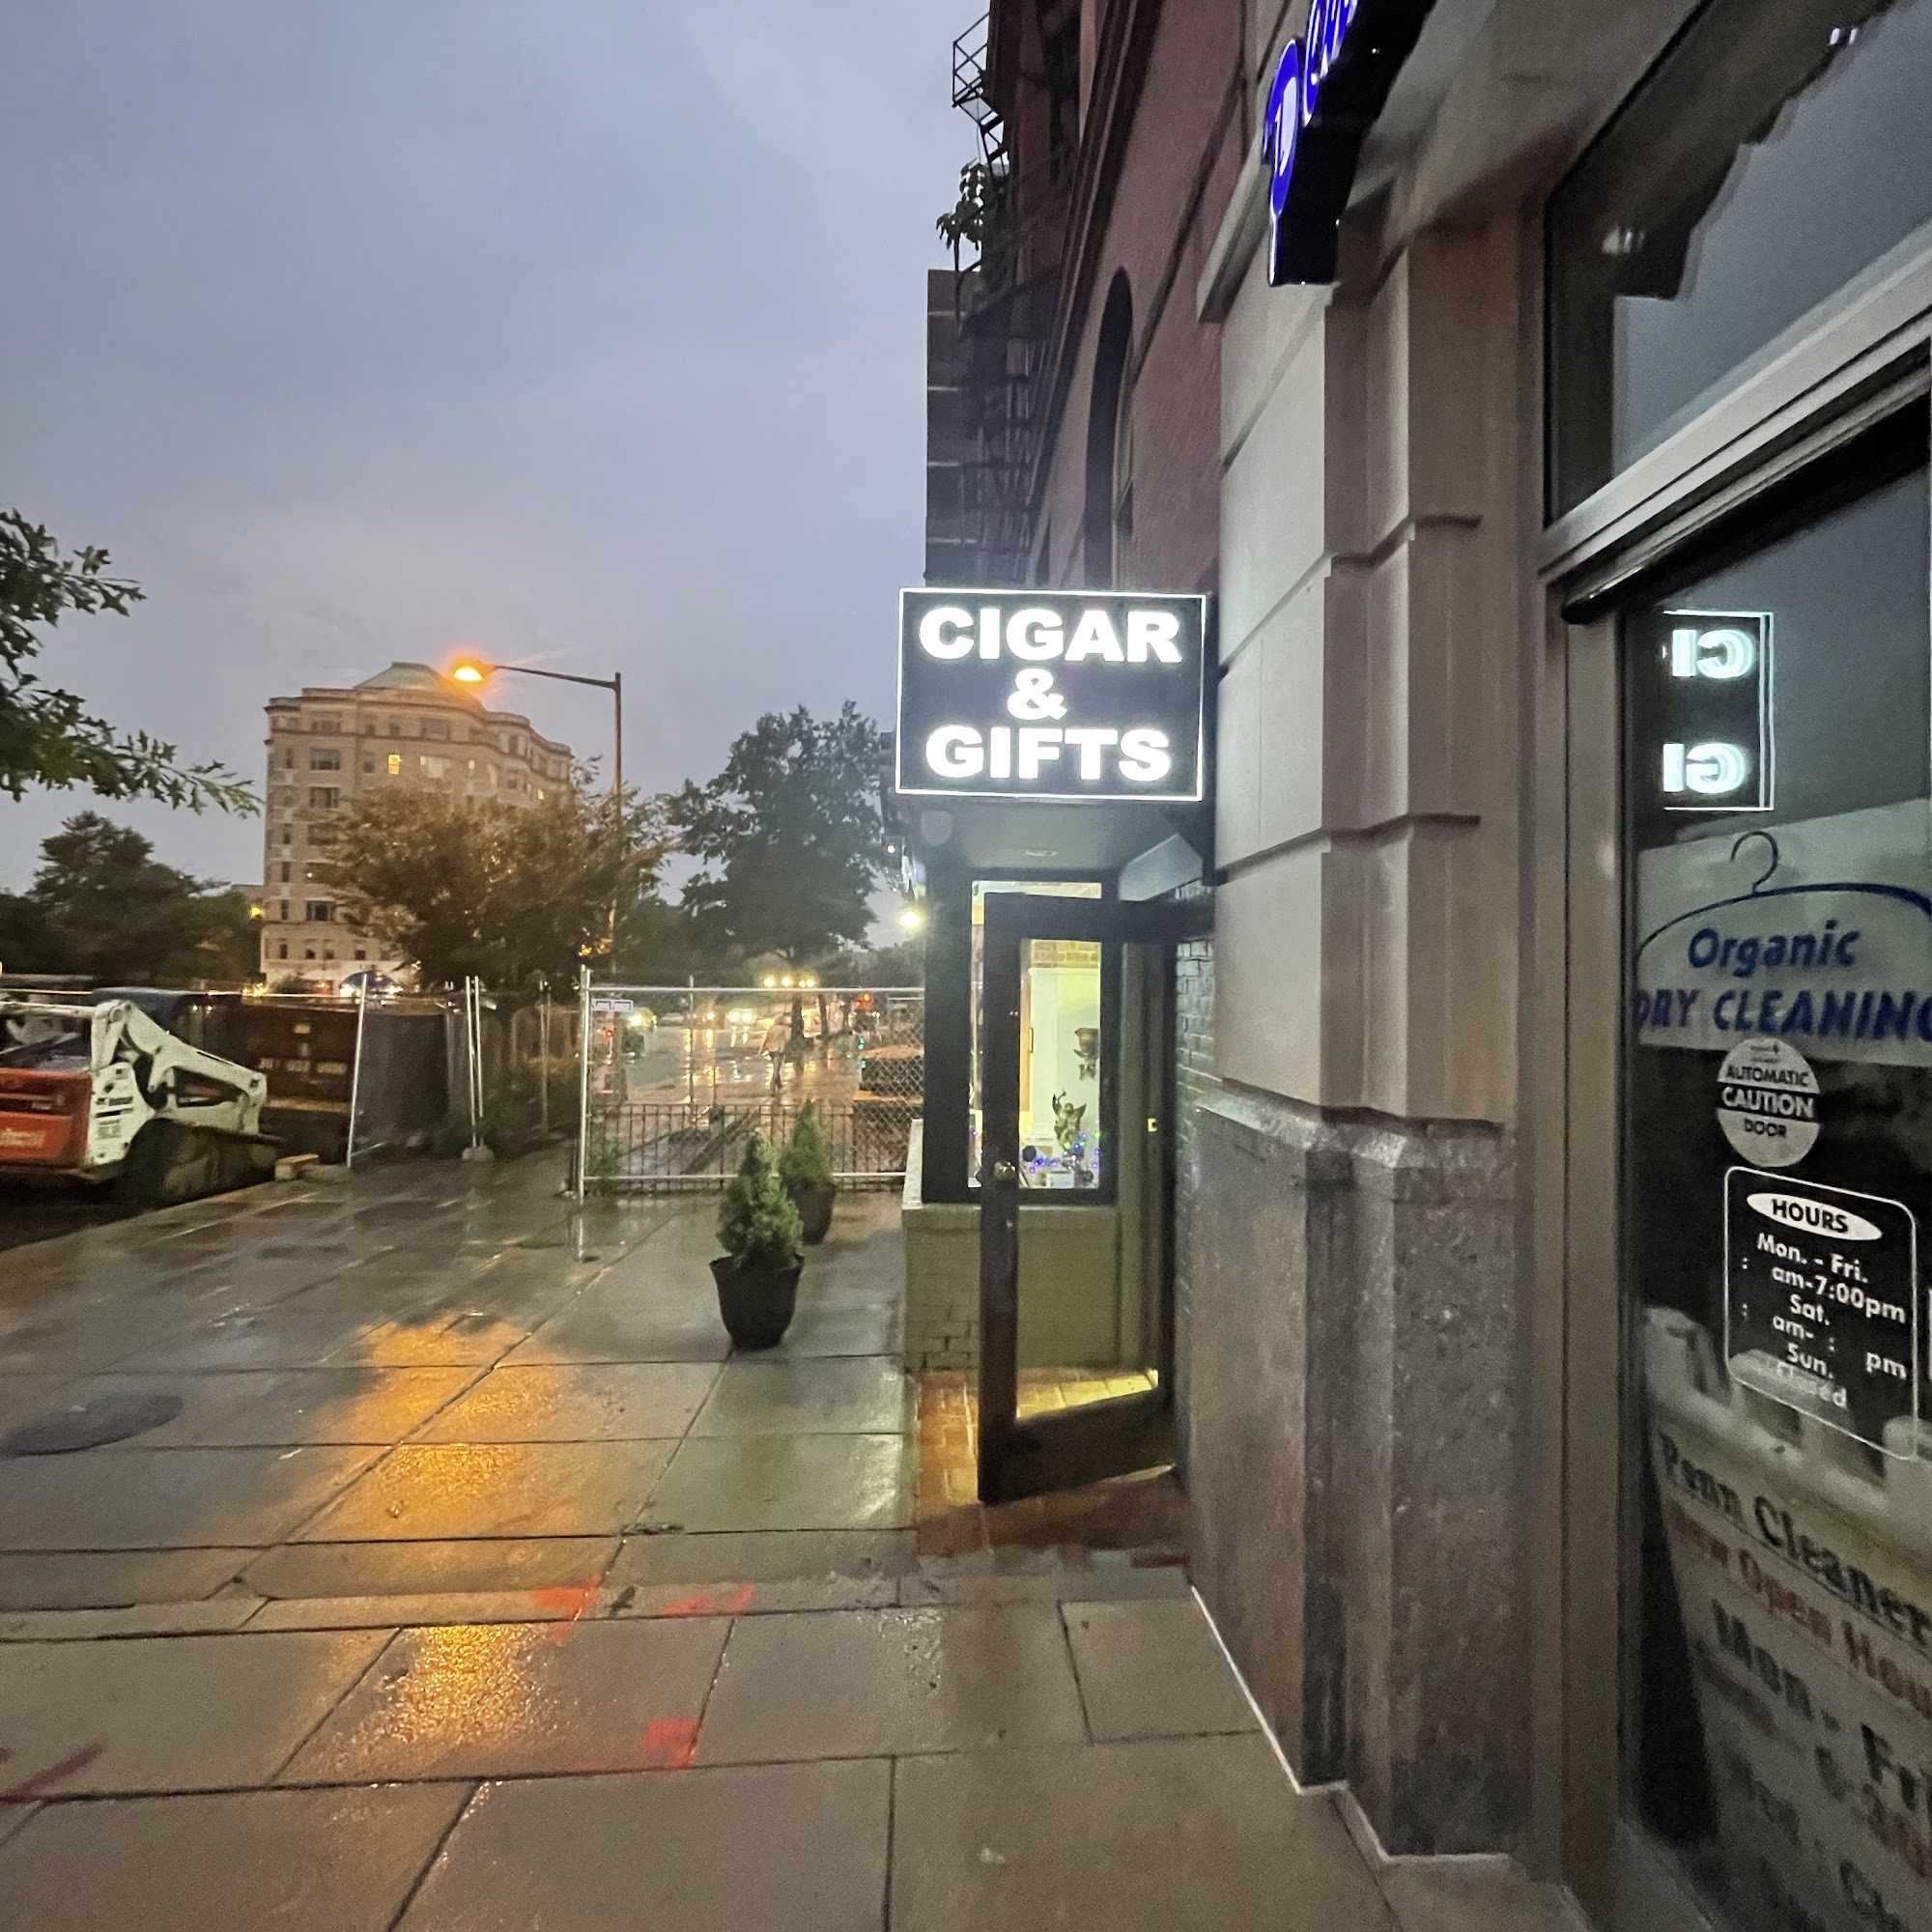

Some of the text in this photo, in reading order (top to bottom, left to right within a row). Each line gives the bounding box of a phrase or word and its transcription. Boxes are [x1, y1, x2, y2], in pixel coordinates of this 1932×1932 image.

[920, 607, 1182, 663] CIGAR
[1007, 668, 1068, 721] &
[925, 725, 1171, 781] GIFTS
[1689, 920, 1861, 978] Organic
[1633, 988, 1699, 1028] DRY
[1726, 1065, 1808, 1087] AUTOMATIC
[1722, 1086, 1813, 1118] CAUTION
[1744, 1118, 1787, 1137] DOOR
[1772, 1198, 1848, 1234] HOURS
[1757, 1233, 1807, 1264] Mon.
[1831, 1254, 1868, 1284] Fri.
[1790, 1294, 1831, 1325] Sat.
[1787, 1343, 1833, 1378] Sun.
[1866, 1352, 1906, 1379] pm
